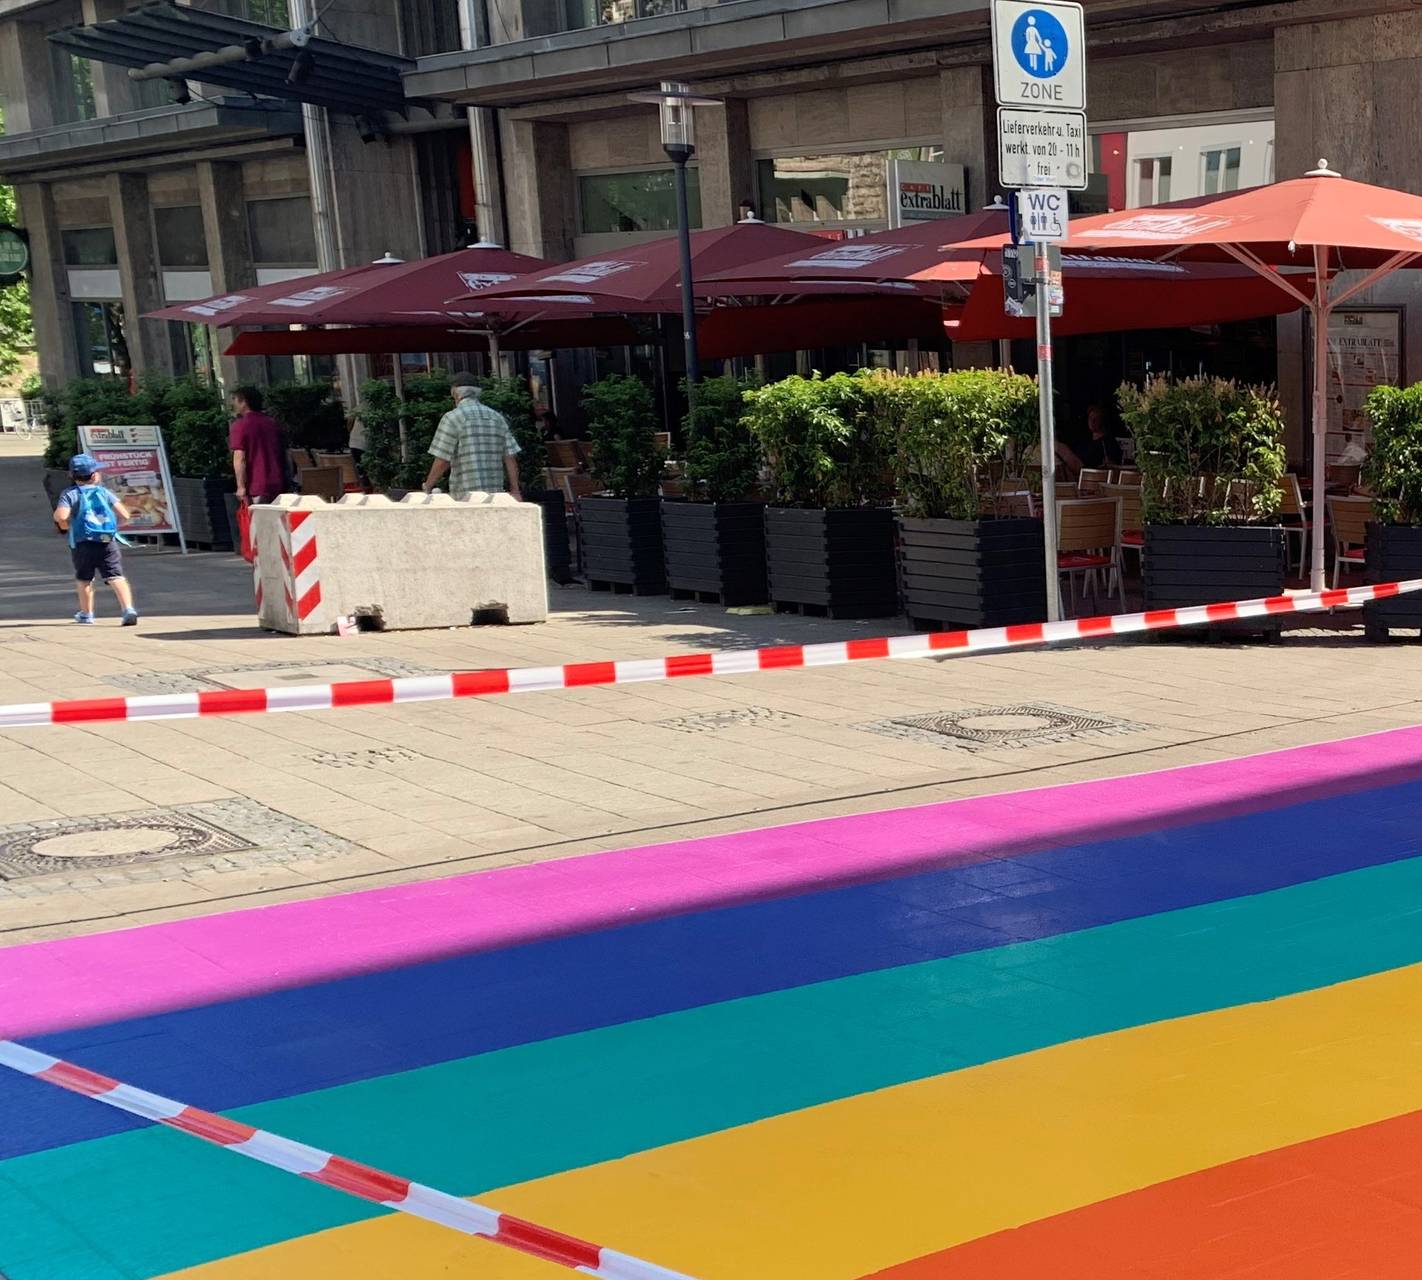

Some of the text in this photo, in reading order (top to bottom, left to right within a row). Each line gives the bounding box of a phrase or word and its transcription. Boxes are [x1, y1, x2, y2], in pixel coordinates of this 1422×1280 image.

[1020, 82, 1063, 101] ZONE
[1002, 119, 1055, 135] Lieferverkehr
[1066, 123, 1081, 138] Taxi
[1005, 141, 1030, 155] werkt.
[1032, 144, 1046, 155] von
[1048, 142, 1057, 156] 20
[1066, 143, 1074, 157] 11
[1075, 144, 1080, 158] h
[1037, 162, 1051, 176] frei
[900, 184, 961, 211] extrablatt
[1028, 193, 1061, 211] WC
